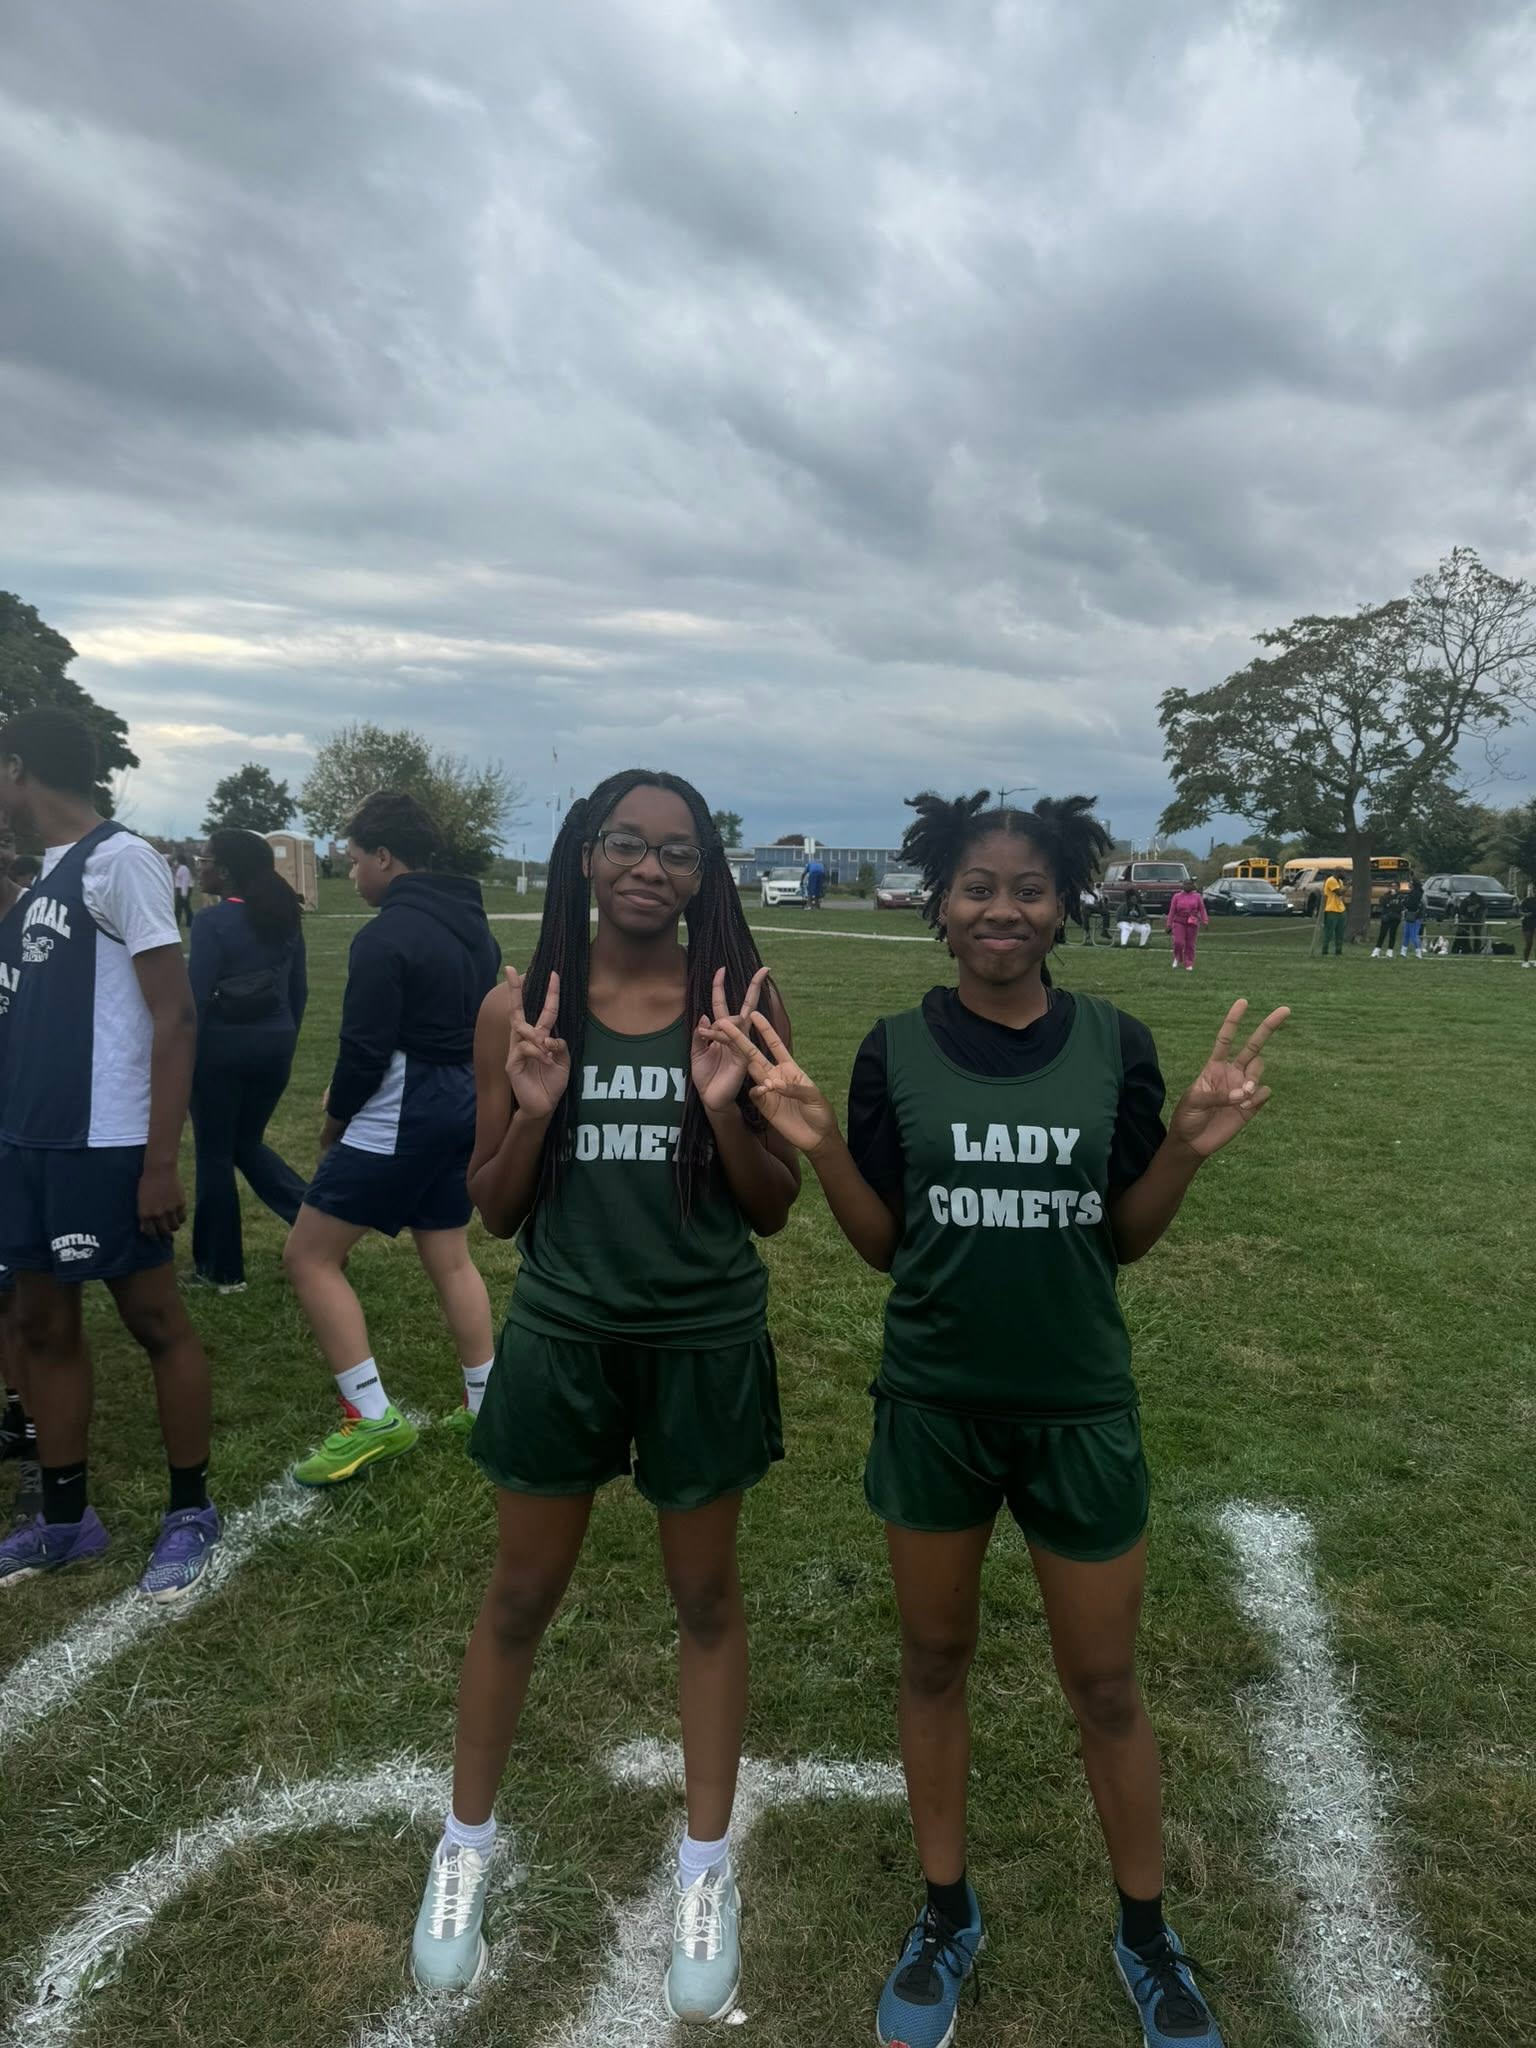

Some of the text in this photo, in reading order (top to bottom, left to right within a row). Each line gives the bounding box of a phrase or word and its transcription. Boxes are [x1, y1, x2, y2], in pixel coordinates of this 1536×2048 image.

[581, 1065, 688, 1102] LADY
[951, 1123, 1081, 1165] LADY
[928, 1185, 1103, 1229] COMETS
[51, 1233, 100, 1251] CENTRAL
